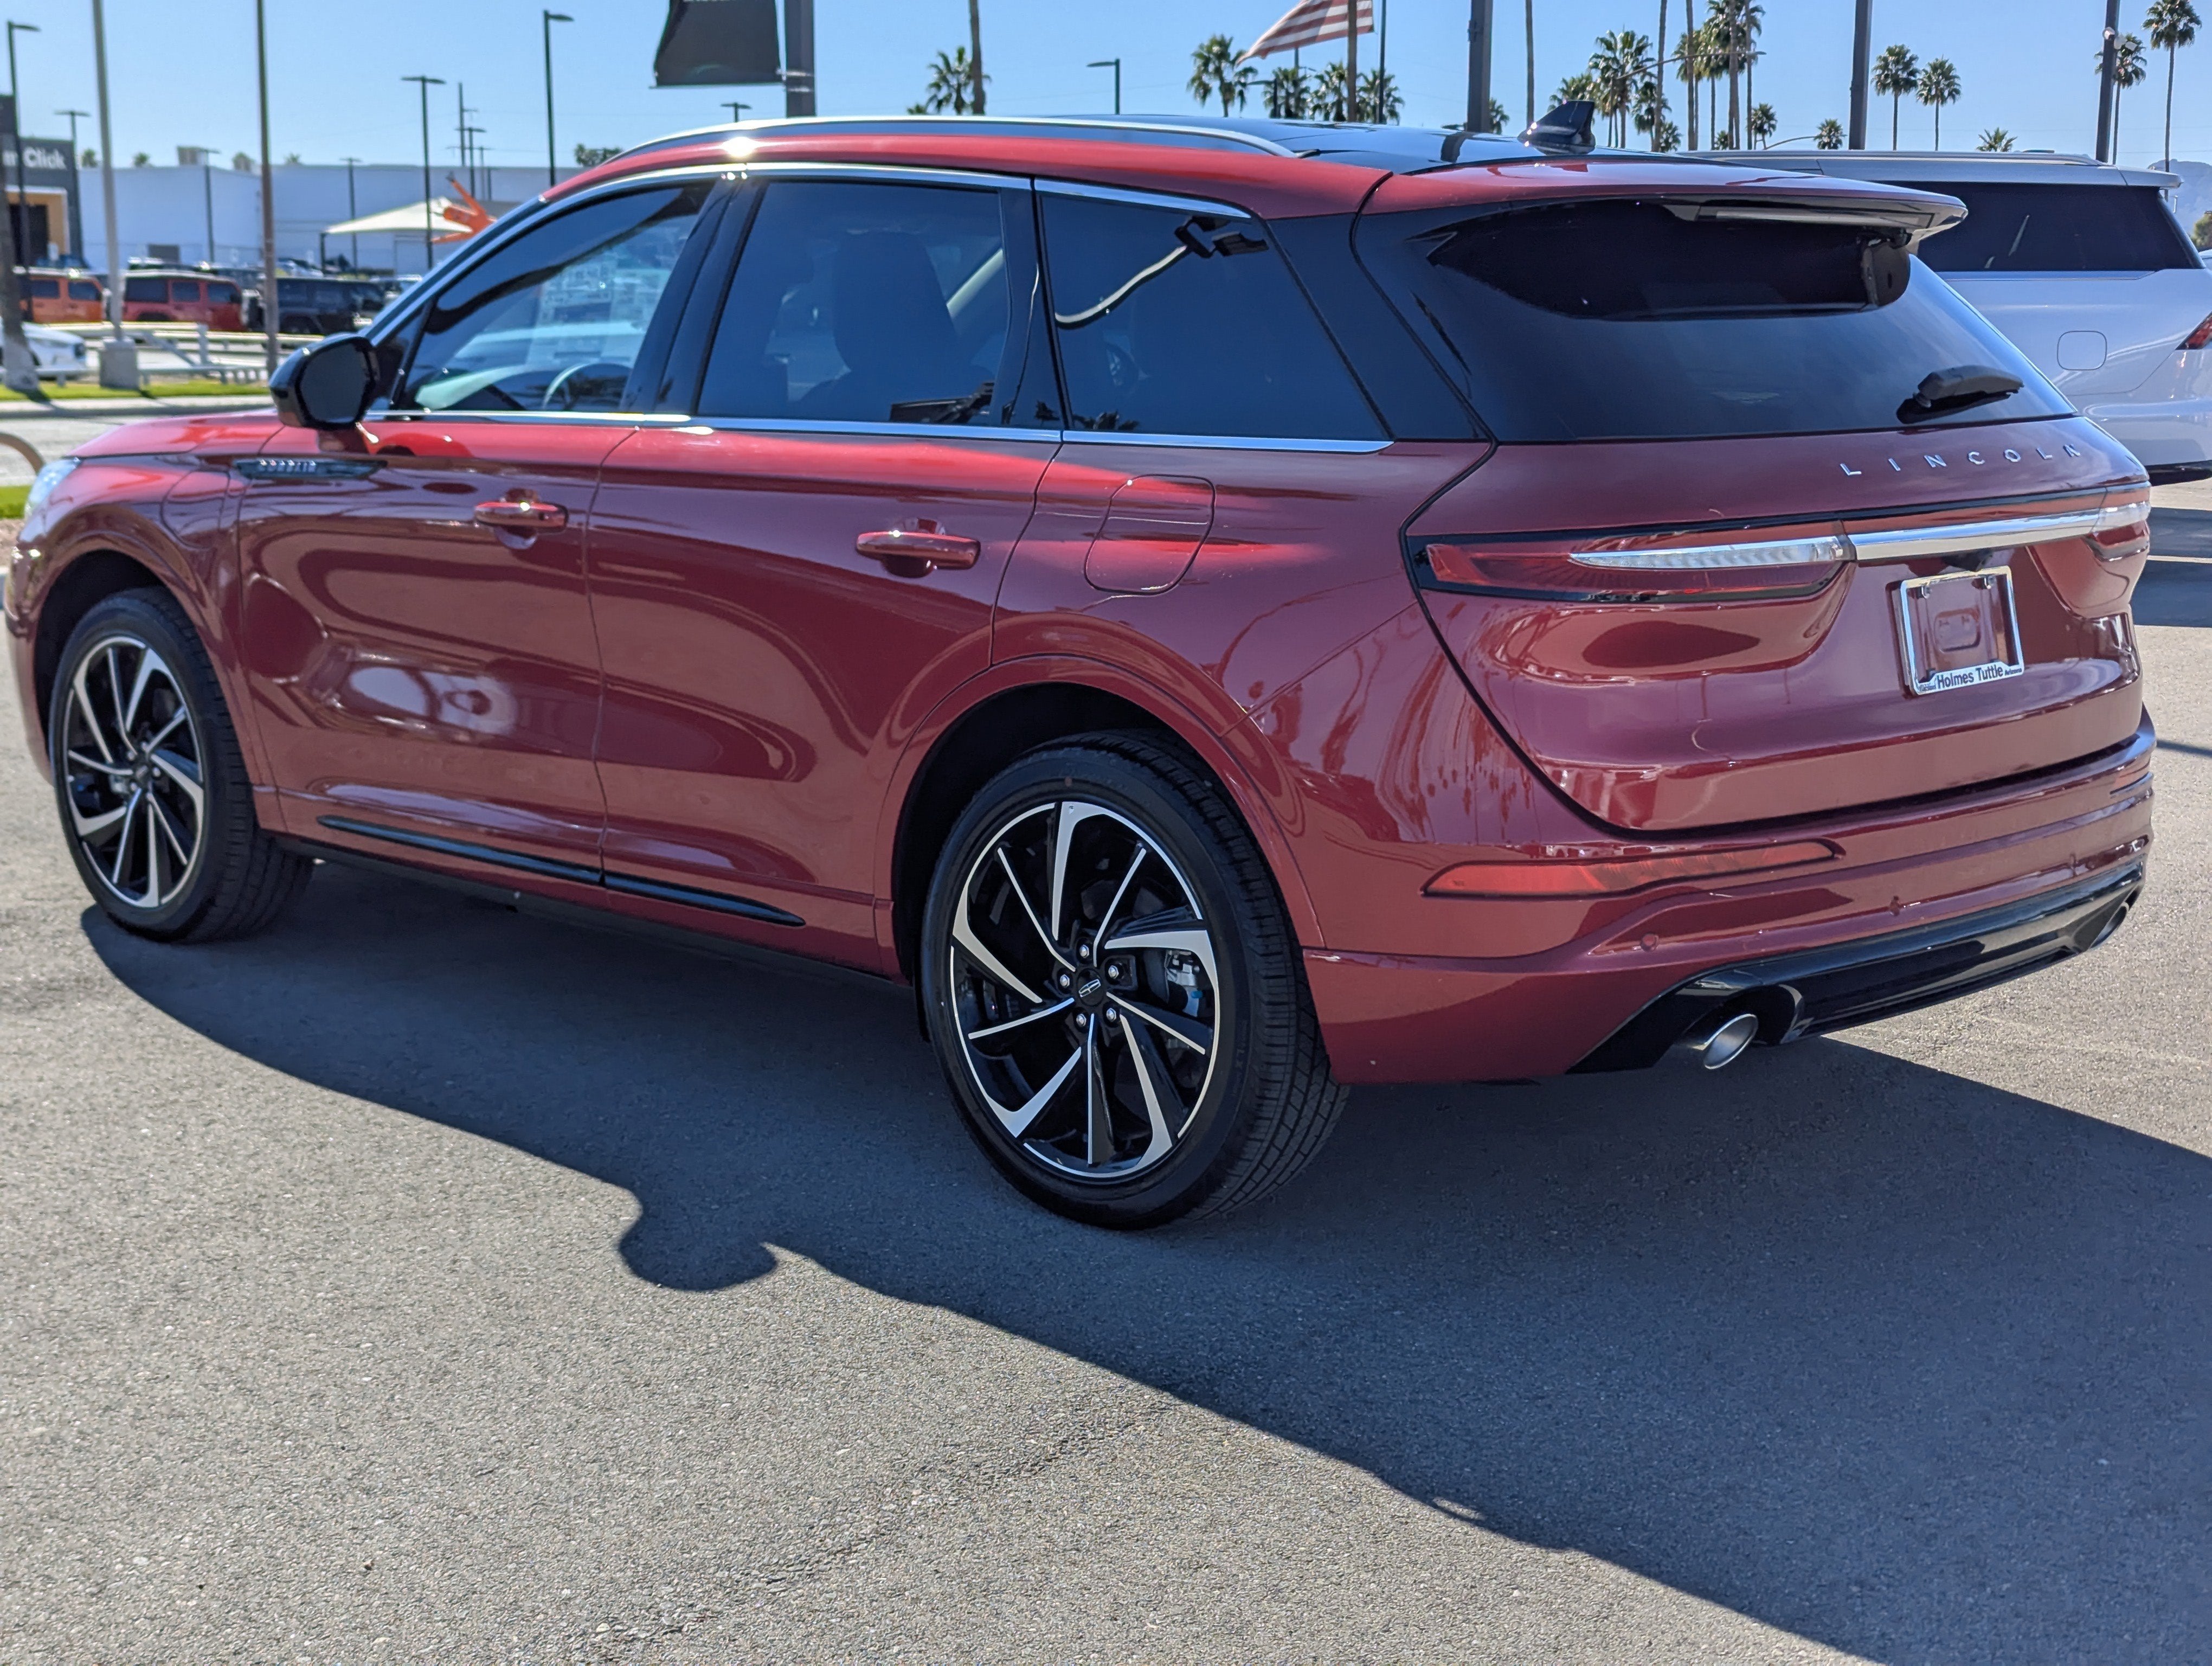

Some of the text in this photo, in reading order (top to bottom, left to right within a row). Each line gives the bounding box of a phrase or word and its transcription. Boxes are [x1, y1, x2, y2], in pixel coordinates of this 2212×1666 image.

[23, 147, 67, 170] Click
[1840, 444, 2081, 476] LINCOLN
[1937, 673, 1975, 689] Holmes
[1975, 664, 2003, 681] Tuttle
